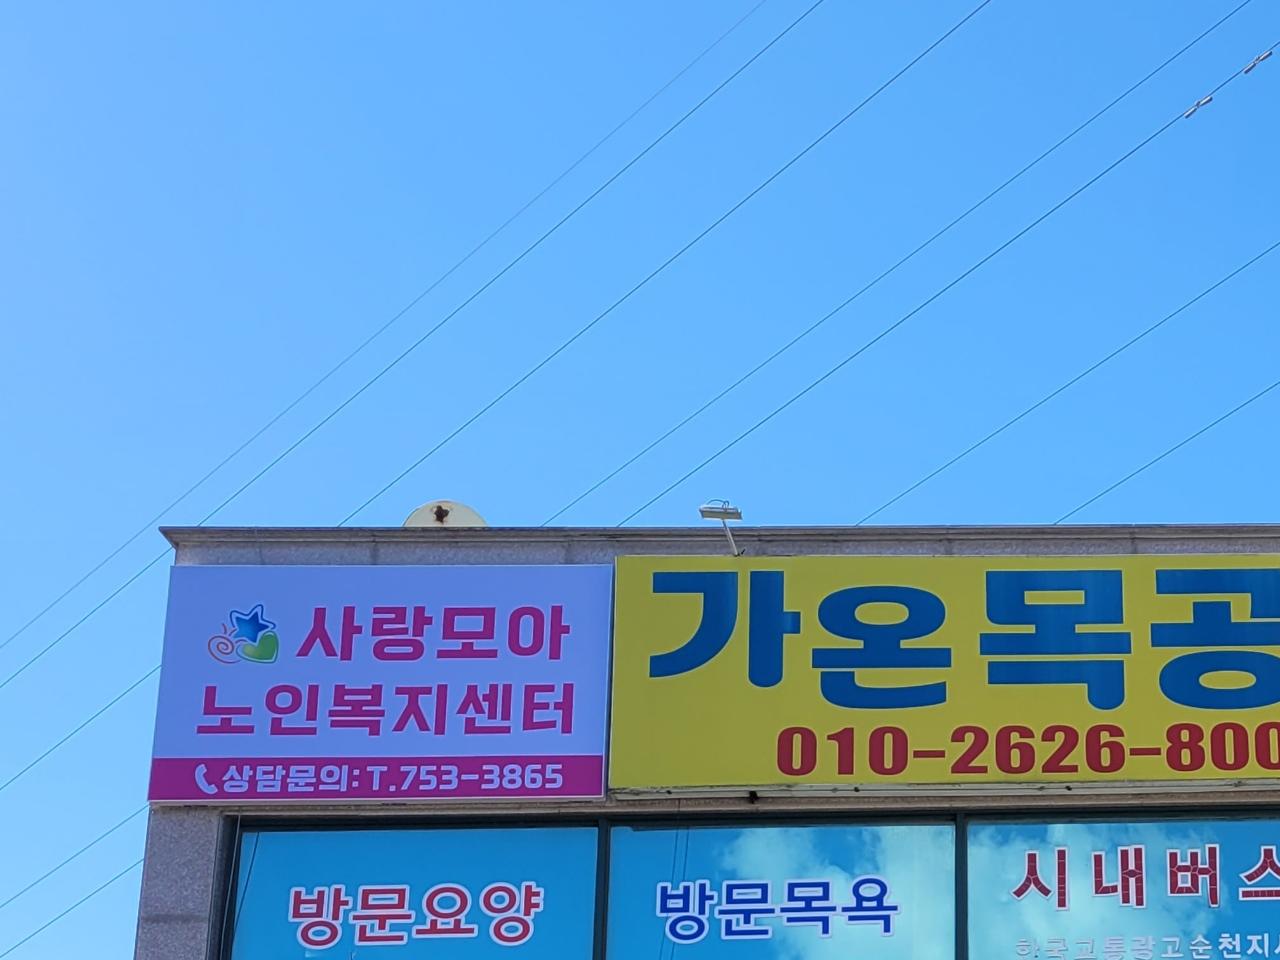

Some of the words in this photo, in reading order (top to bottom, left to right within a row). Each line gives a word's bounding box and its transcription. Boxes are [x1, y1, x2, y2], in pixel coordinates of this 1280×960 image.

[295, 603, 571, 662] 사랑모아
[195, 681, 575, 738] 노인복지센터
[288, 880, 545, 950] 방문요양
[655, 873, 898, 945] 방문목욕
